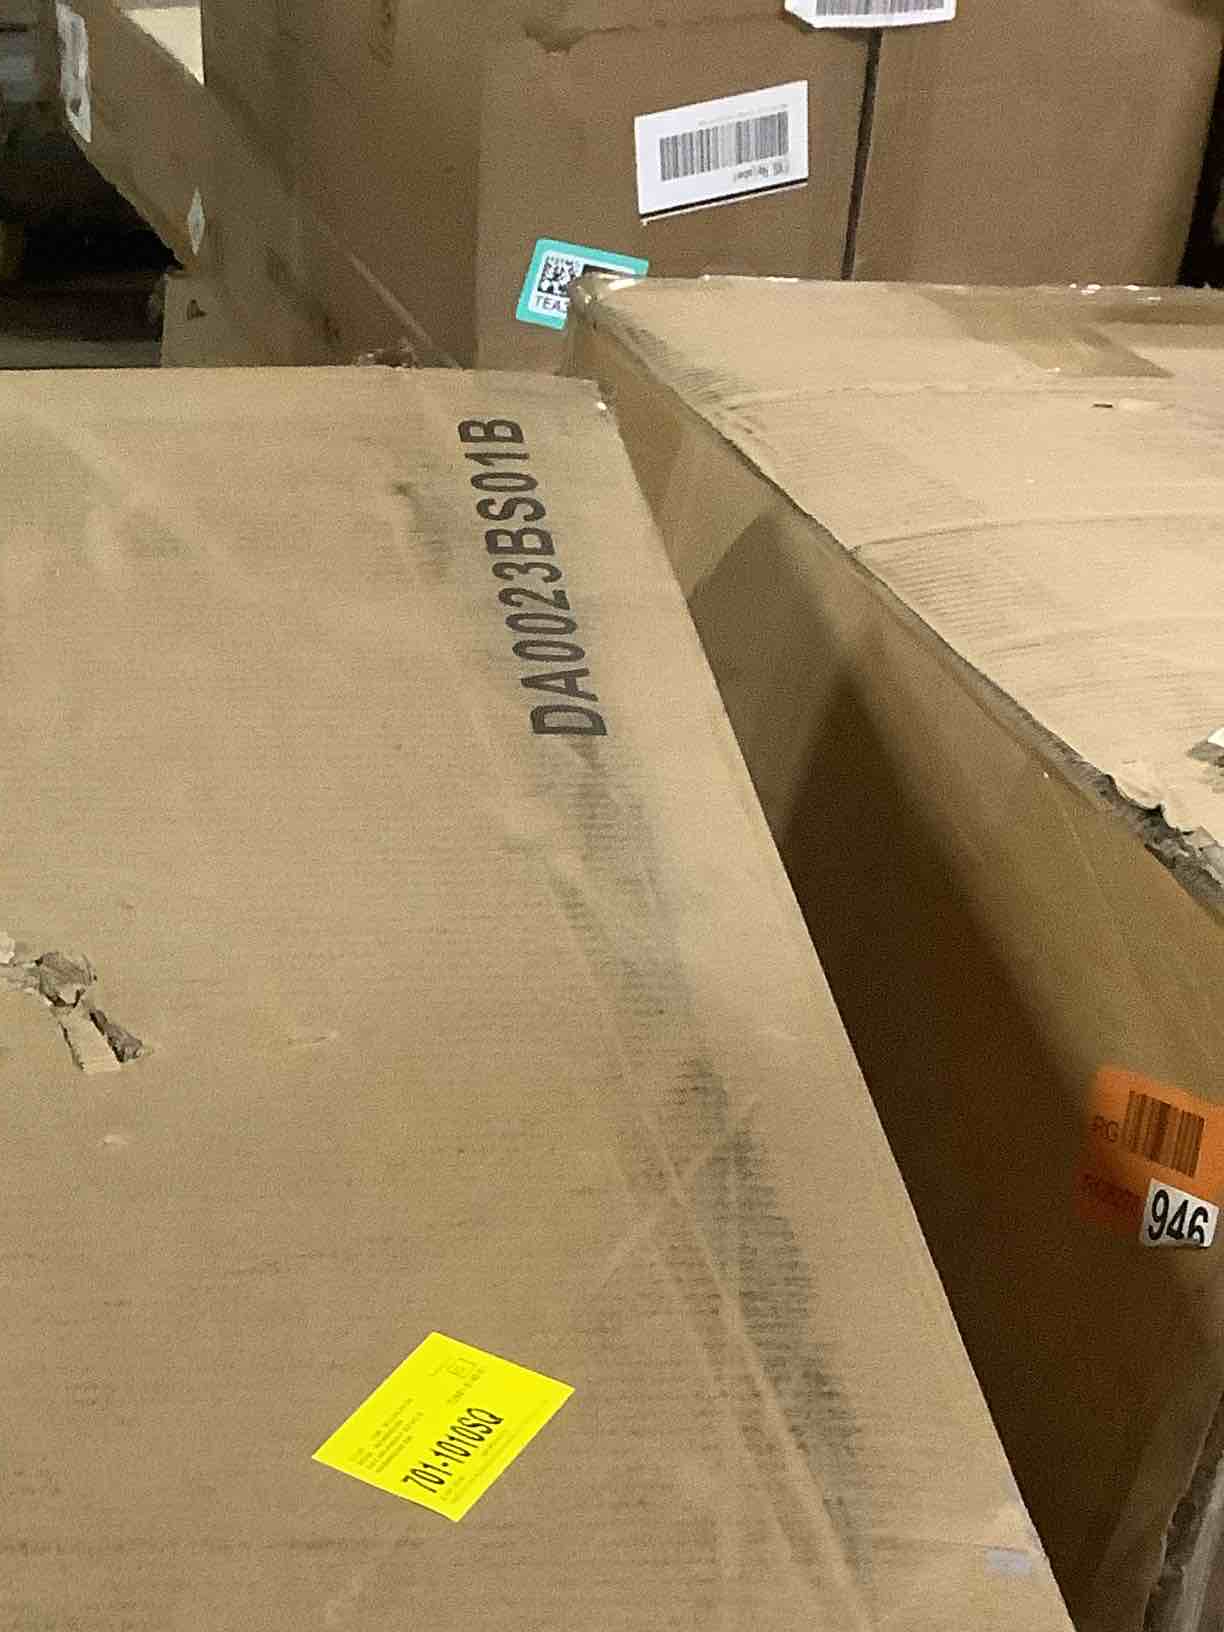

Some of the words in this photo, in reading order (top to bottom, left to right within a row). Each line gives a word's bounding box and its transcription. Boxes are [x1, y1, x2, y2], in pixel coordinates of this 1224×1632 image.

[459, 417, 608, 737] DA0023BS01B
[1148, 1189, 1209, 1248] 946
[402, 1407, 504, 1493] 701-1010SQ
